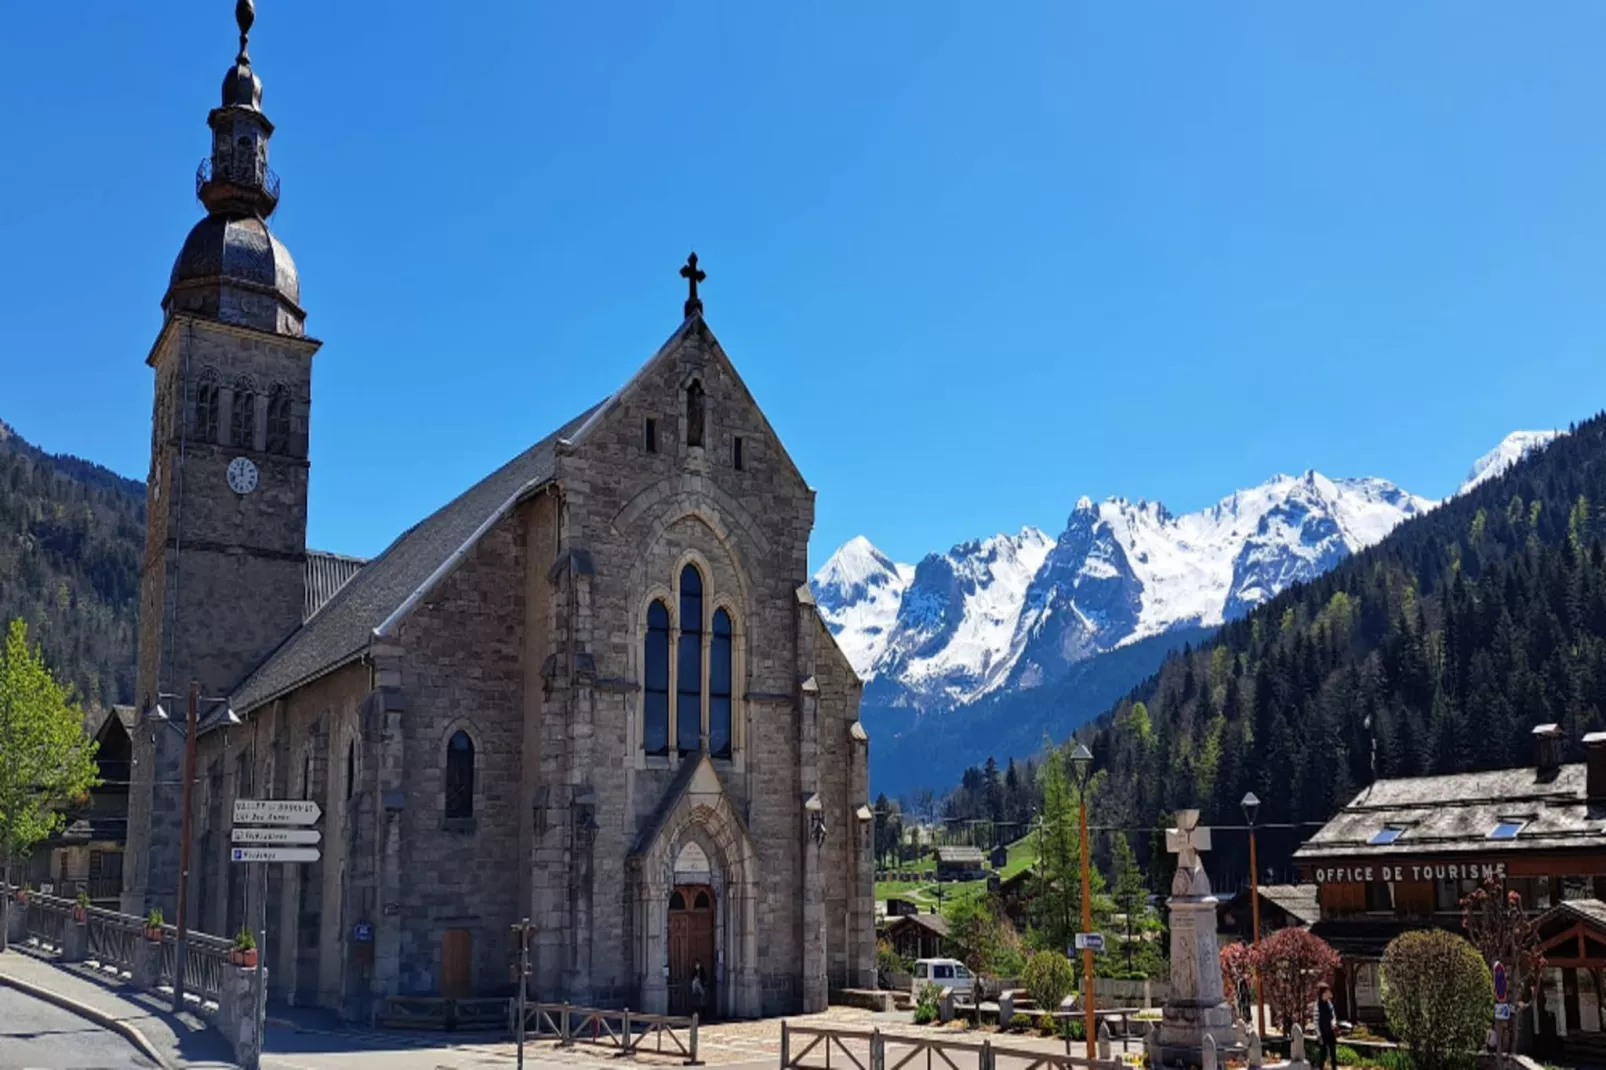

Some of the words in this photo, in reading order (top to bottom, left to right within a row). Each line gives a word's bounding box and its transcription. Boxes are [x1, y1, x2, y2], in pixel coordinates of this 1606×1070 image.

[1316, 867, 1373, 882] OFFICE
[1383, 866, 1403, 881] DE
[1412, 863, 1508, 881] TOURISME
